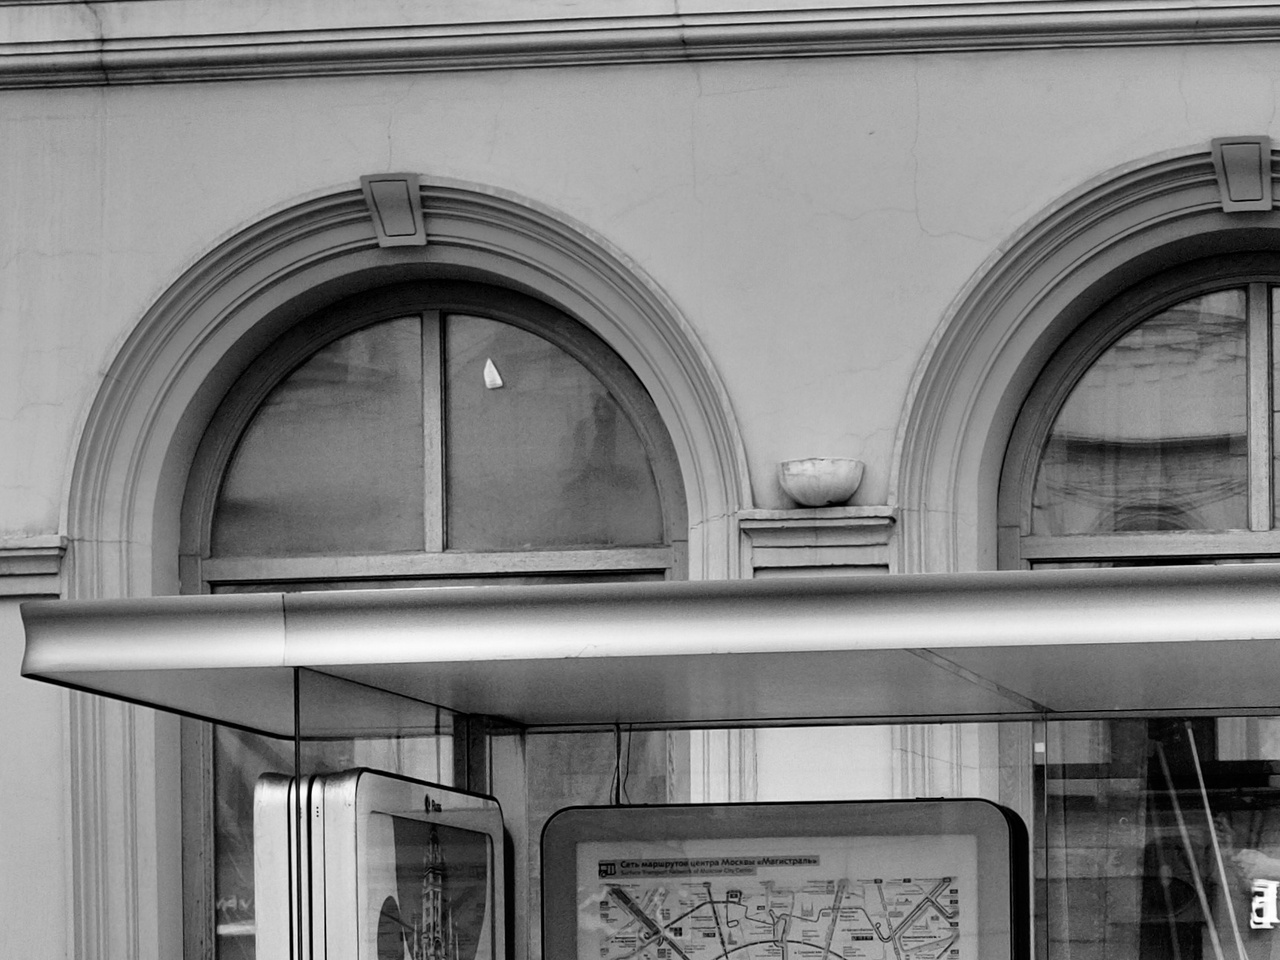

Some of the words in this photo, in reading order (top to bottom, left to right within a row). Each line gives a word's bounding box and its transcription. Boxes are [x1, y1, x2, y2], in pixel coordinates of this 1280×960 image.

[620, 860, 640, 868] Сеть
[641, 860, 689, 870] маршрутов
[690, 860, 719, 868] центра
[721, 859, 755, 867] Москвы
